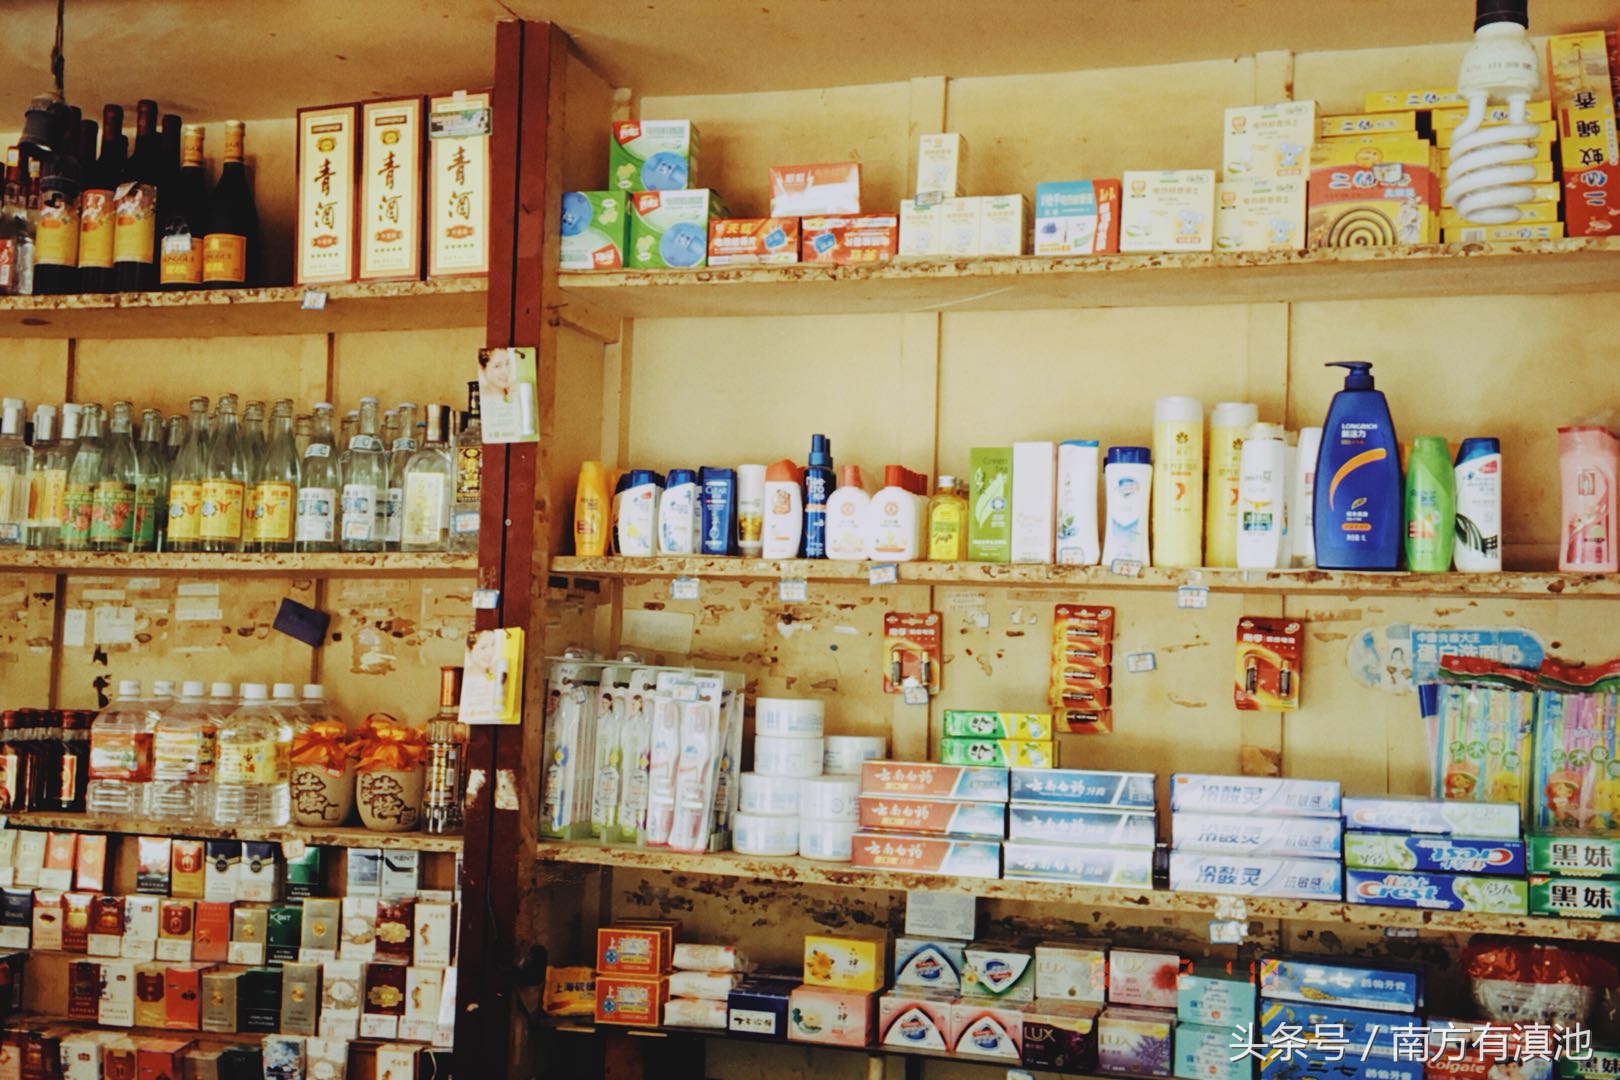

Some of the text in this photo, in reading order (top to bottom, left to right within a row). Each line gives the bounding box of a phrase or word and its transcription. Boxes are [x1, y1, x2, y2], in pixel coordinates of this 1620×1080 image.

[1574, 90, 1605, 166] 蚊蝇香
[1552, 844, 1612, 867] 黑妹
[1196, 865, 1262, 886] 冷酸灵
[1358, 881, 1440, 900] Crest
[1552, 885, 1612, 909] 黑妹
[1302, 969, 1355, 989] 三七
[1023, 1026, 1056, 1042] LUX
[1100, 1034, 1134, 1048] LUX
[1427, 1059, 1486, 1074] Colgate
